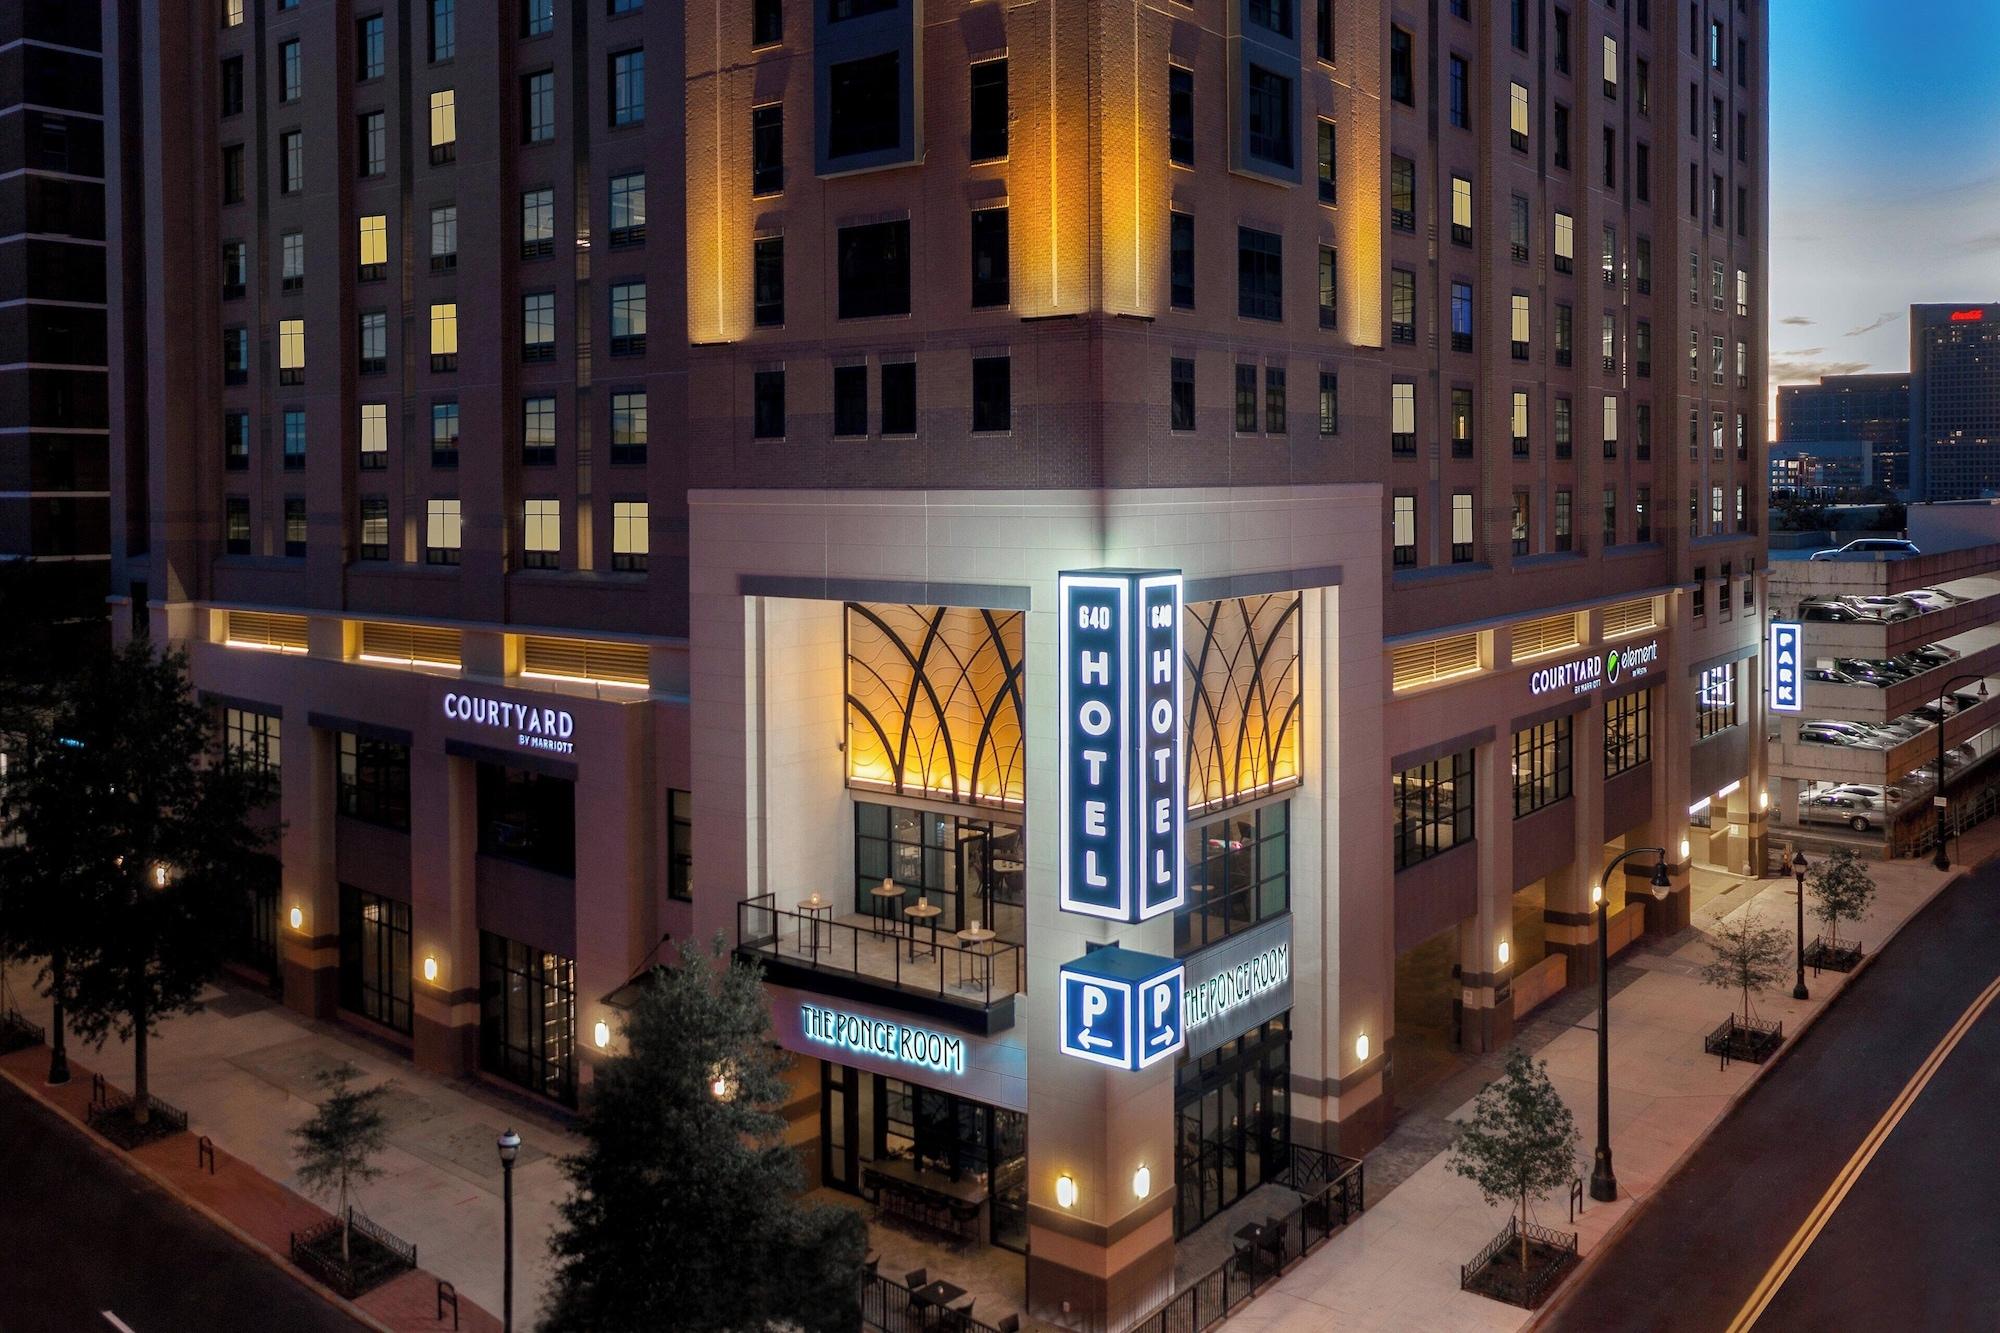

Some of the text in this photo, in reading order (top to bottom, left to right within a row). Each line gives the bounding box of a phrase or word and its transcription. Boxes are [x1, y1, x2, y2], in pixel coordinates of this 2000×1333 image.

[1079, 605, 1110, 630] 640
[1151, 604, 1172, 629] 640
[1531, 655, 1602, 695] COURTYARD
[1621, 639, 1658, 669] element
[1778, 633, 1794, 700] PARK
[444, 692, 574, 738] COURTYARD
[519, 734, 574, 754] BY MARRIOTT
[1151, 648, 1173, 885] HOTEL
[1079, 650, 1111, 887] HOTEL
[1082, 984, 1107, 1028] P
[1153, 983, 1171, 1029] P
[1184, 943, 1288, 1027] THE PONCE ROOM
[801, 1005, 961, 1072] THE PONCE ROOM
